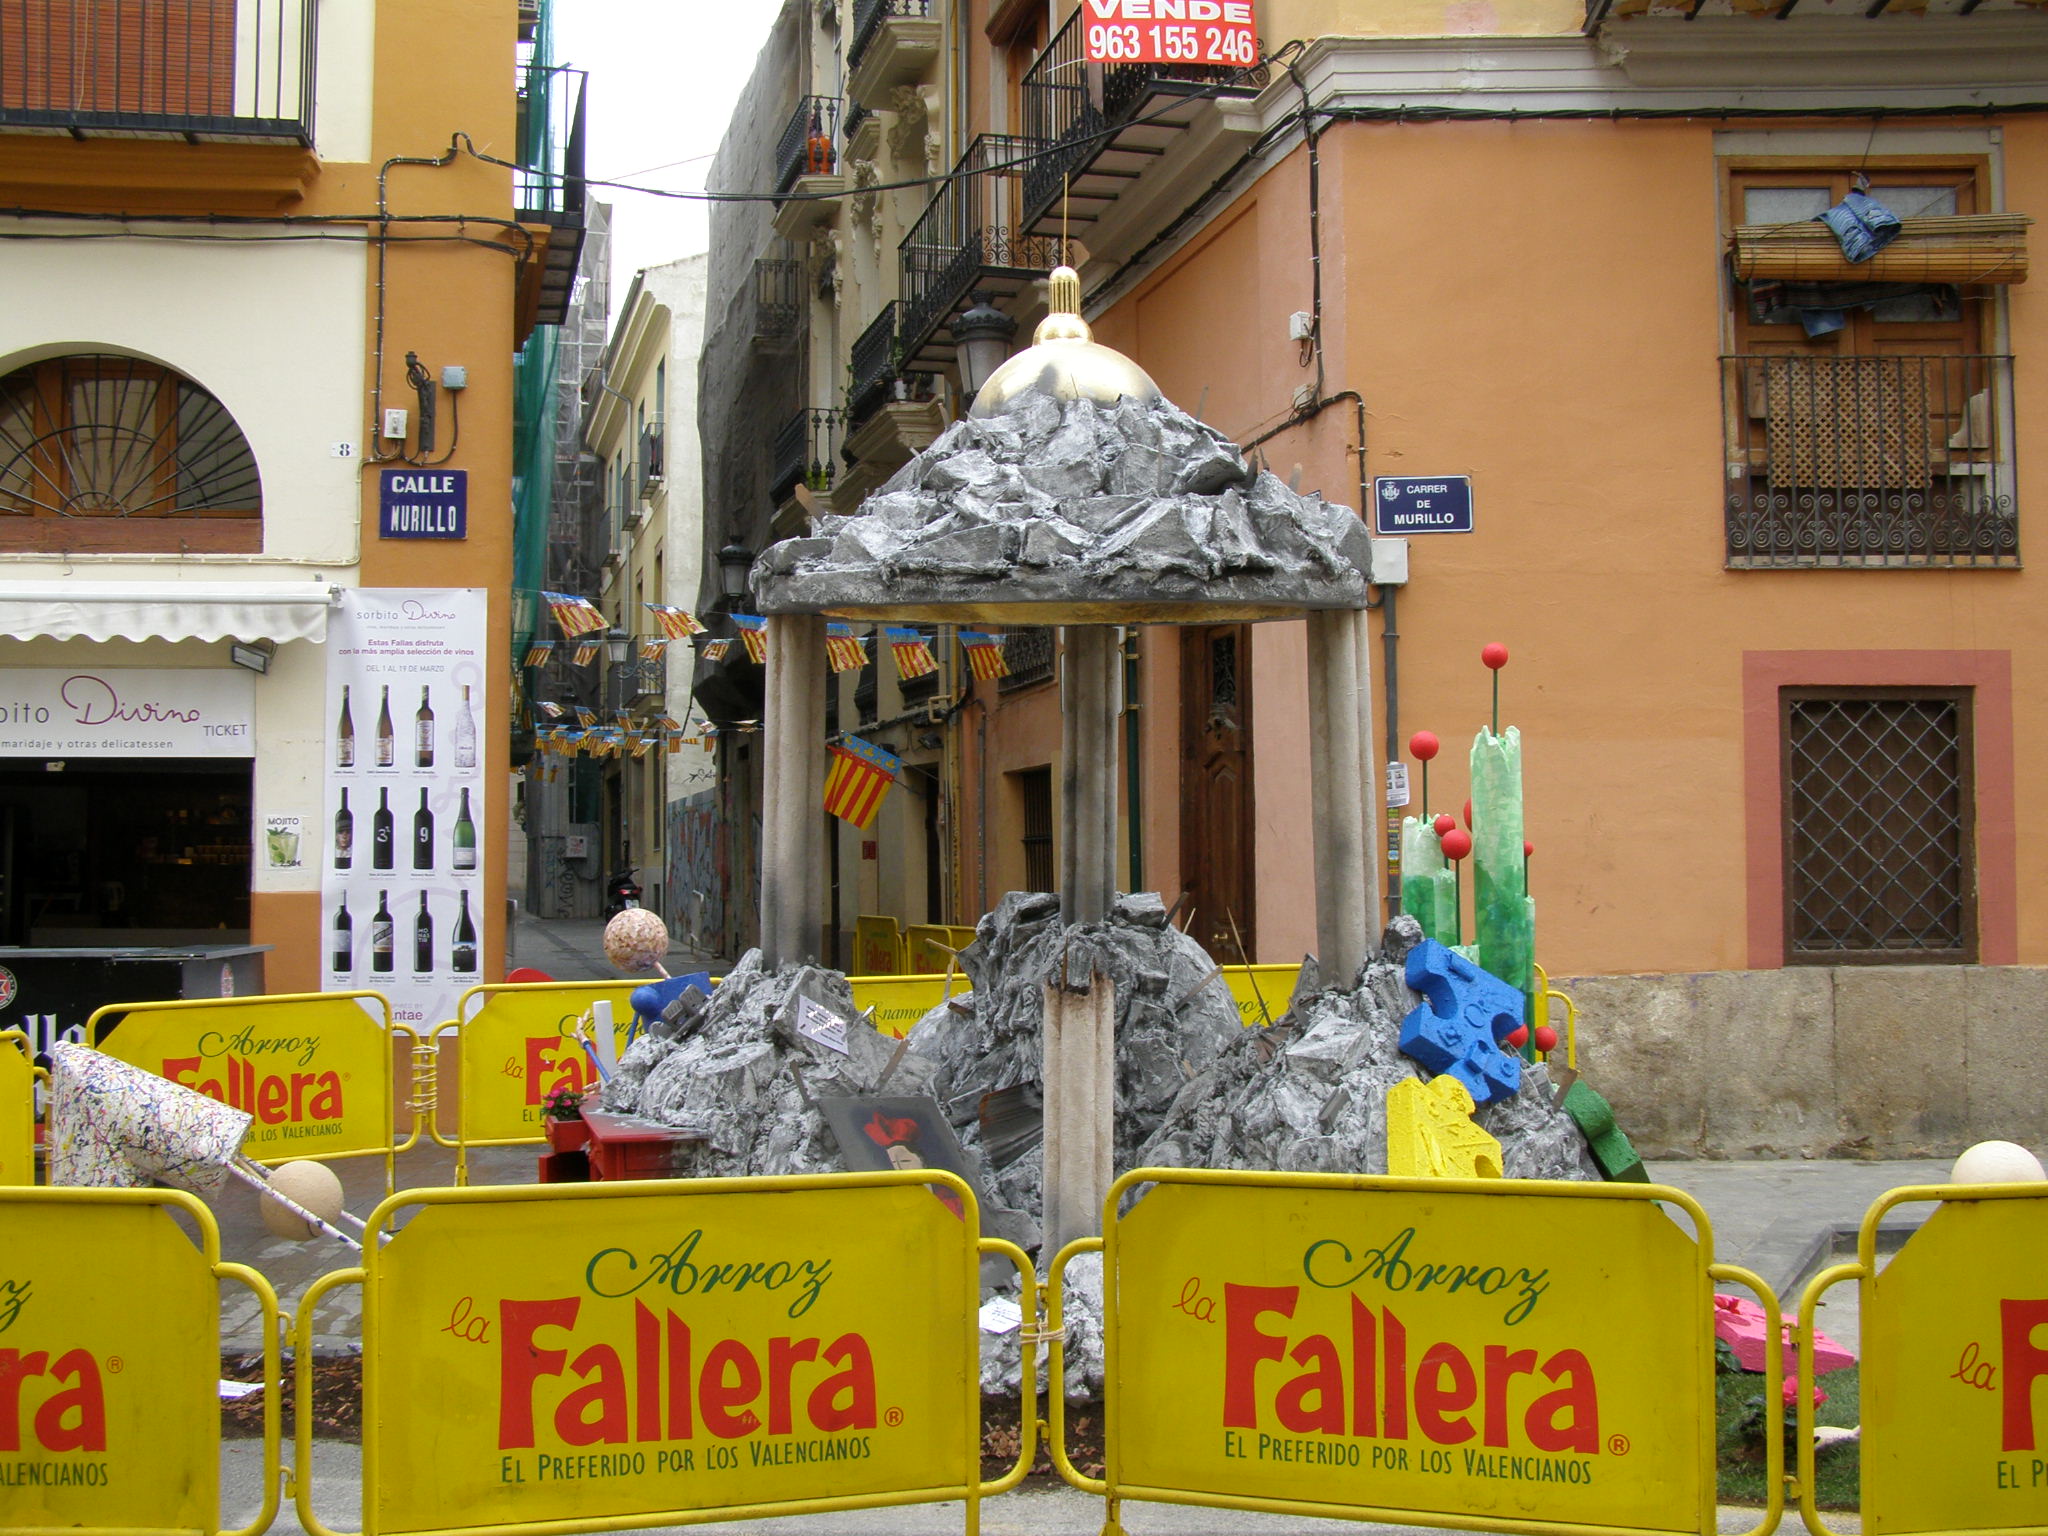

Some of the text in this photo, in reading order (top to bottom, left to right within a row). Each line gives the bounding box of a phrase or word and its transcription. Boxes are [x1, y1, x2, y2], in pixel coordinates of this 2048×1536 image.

[1088, 0, 1252, 24] VENDE
[1089, 25, 1254, 63] 963 155 246
[339, 443, 350, 457] 8
[391, 476, 454, 493] CALLE
[1406, 485, 1448, 494] CARRER
[1416, 500, 1431, 509] DE
[390, 505, 457, 532] MURILLO
[1394, 513, 1454, 525] MURILLO
[357, 610, 399, 620] sorbito
[368, 639, 444, 647] Estas Fallas disfruta
[380, 648, 405, 656] amplia
[420, 665, 445, 673] MARZO
[61, 675, 200, 725] Divino
[203, 724, 248, 736] TICKET
[1, 739, 173, 750] maridaje y otras delicatessen
[268, 817, 299, 825] MOJITO
[419, 827, 429, 842] 9
[198, 1025, 320, 1067] Arroz
[501, 1056, 524, 1079] la
[261, 1129, 278, 1142] LOS
[282, 1122, 344, 1140] VALENCIANOS
[586, 1229, 833, 1319] Arroz
[1303, 1227, 1550, 1326] Arroz
[441, 1296, 878, 1450] la Fallera
[1172, 1277, 1600, 1455] la Fallera
[1950, 1342, 1997, 1391] la
[502, 1436, 871, 1484] EL PREFERIDO POR LOS VALENCIANOS
[1224, 1431, 1592, 1486] EL PREFERIDO POR LOS VALENCIANOS
[1997, 1461, 2020, 1489] EL
